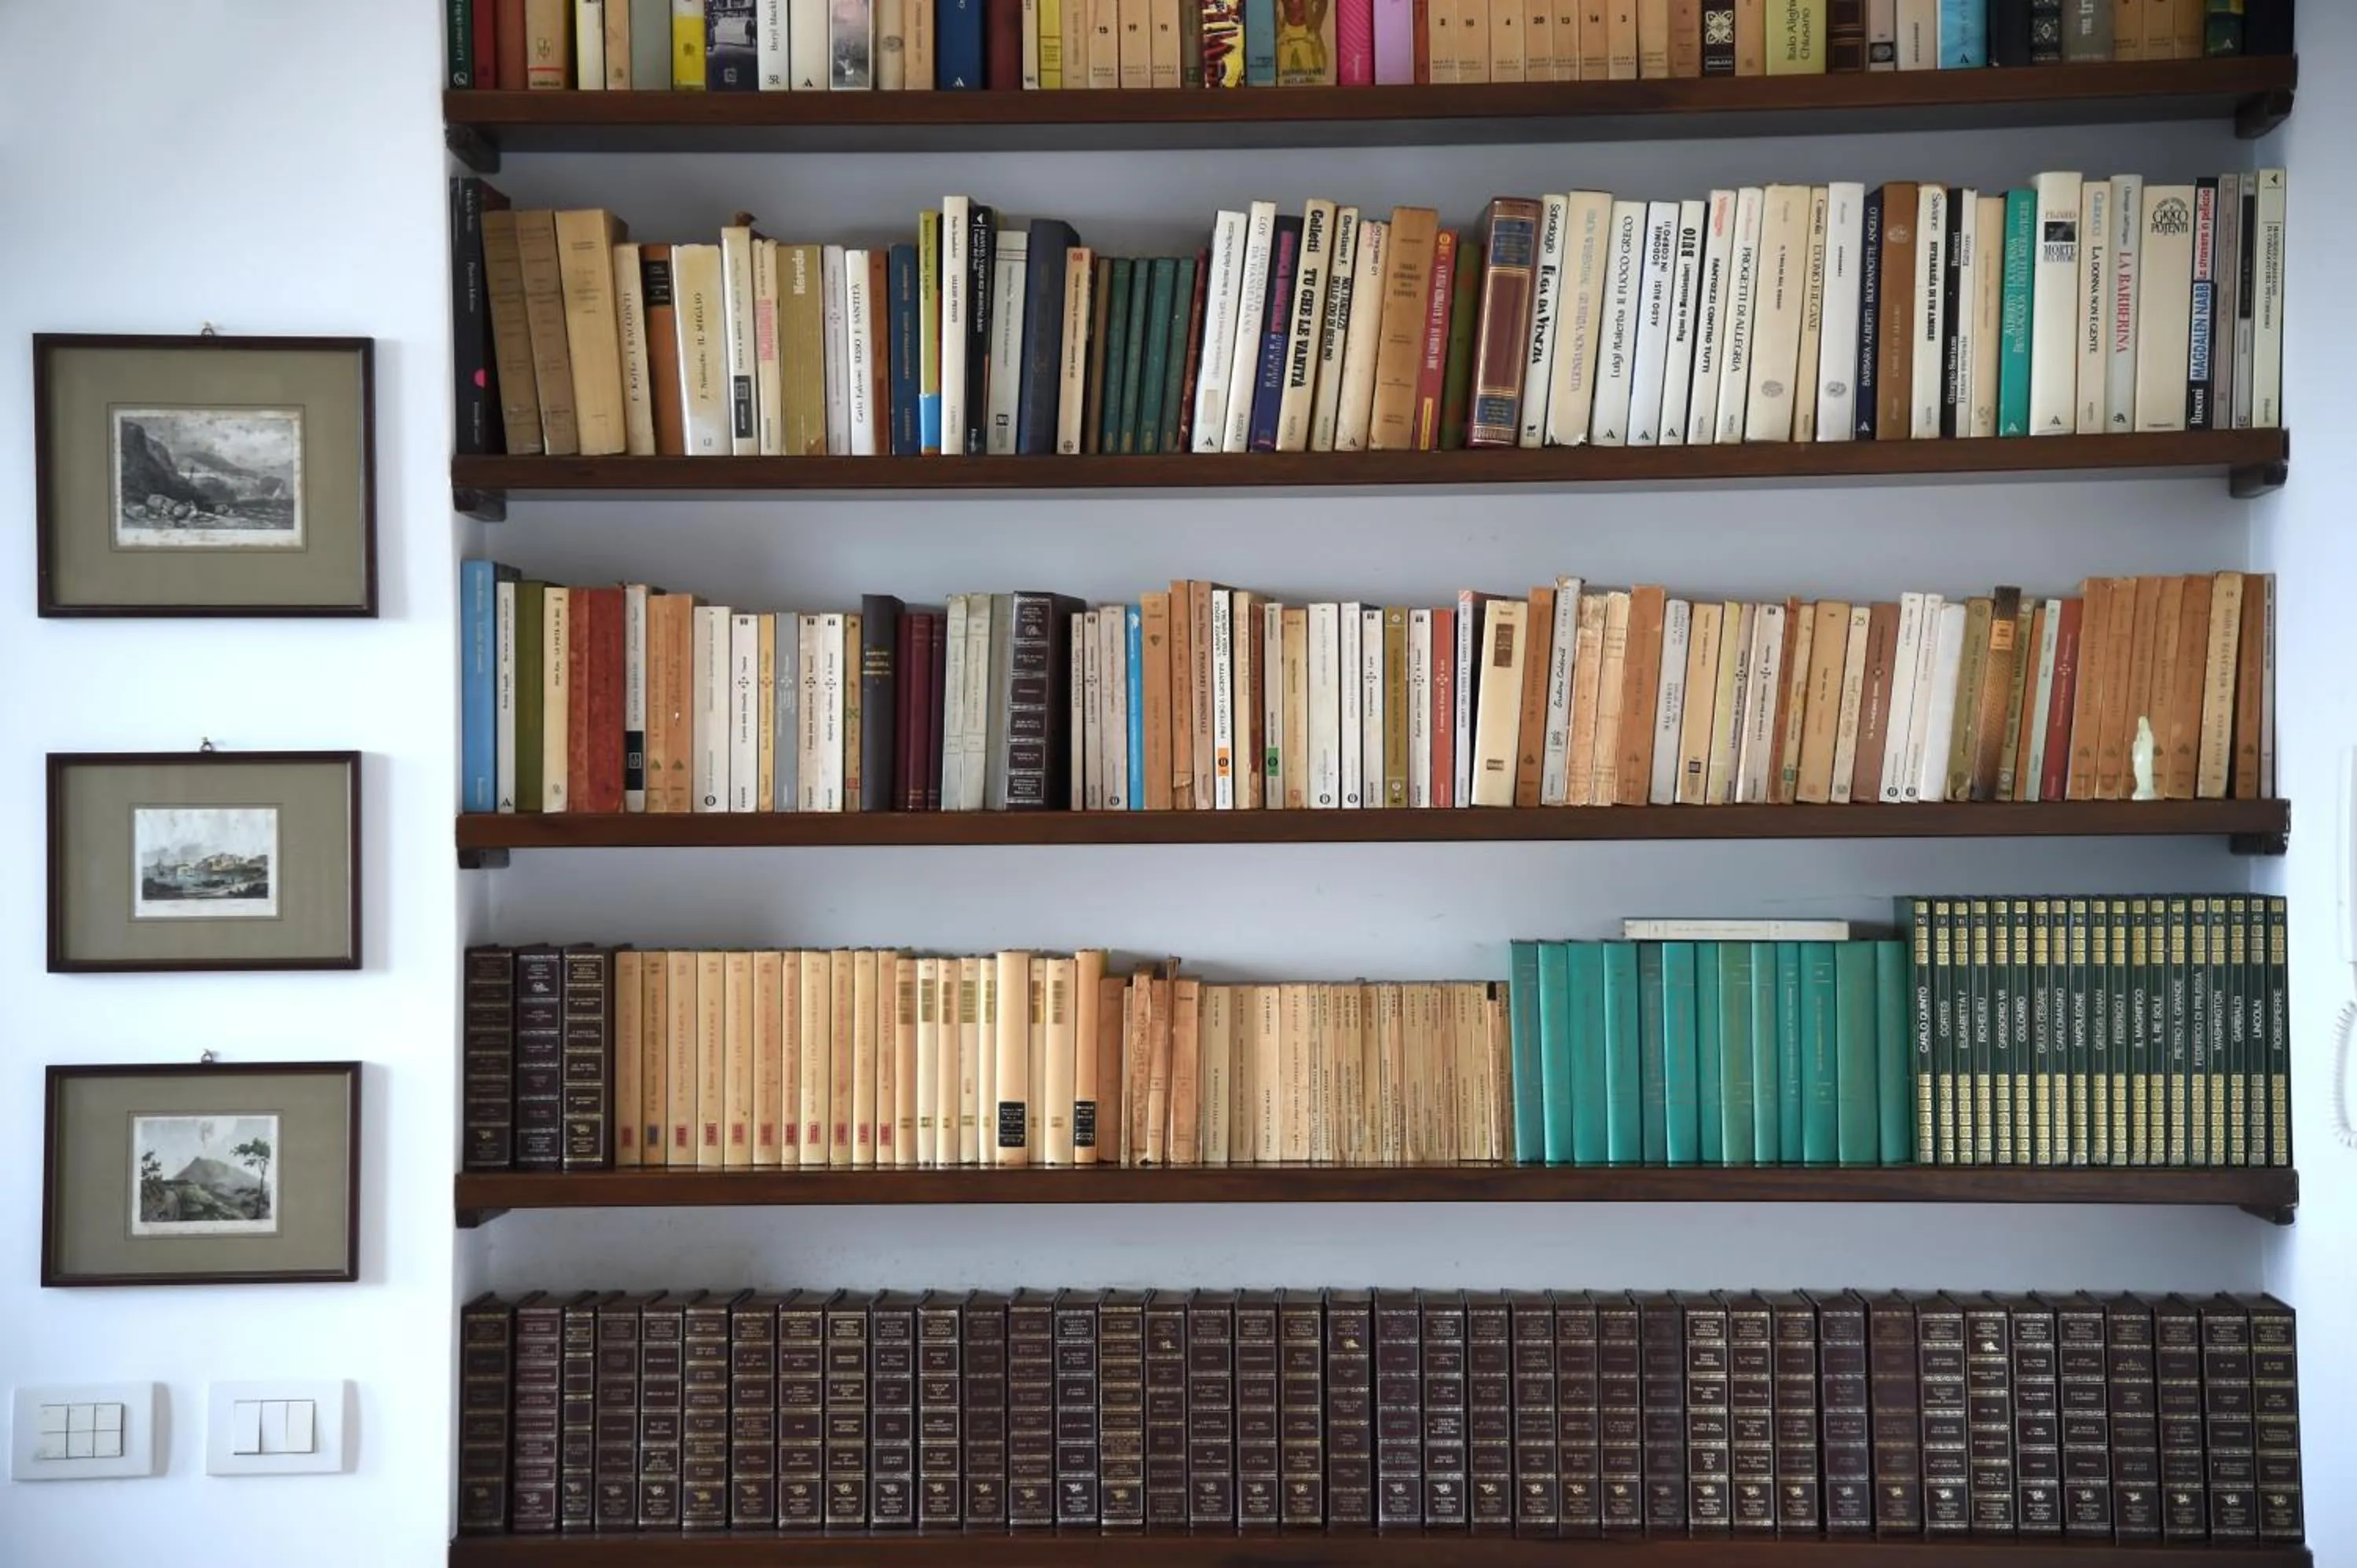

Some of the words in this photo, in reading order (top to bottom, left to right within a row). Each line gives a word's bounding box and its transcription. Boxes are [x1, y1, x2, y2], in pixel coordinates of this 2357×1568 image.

[769, 29, 780, 51] Beryl
[1787, 36, 1798, 61] Italo
[1800, 7, 1811, 60] Chiusano
[1814, 199, 1825, 235] Cassola
[1930, 192, 1942, 230] Saviane
[2200, 189, 2212, 221] pelliccia
[1258, 217, 1267, 236] LOY
[1340, 214, 1352, 259] Christiane
[1544, 203, 1560, 255] Salvalaggio
[1621, 215, 1633, 254] GRECO
[1681, 227, 1696, 258] BUIO
[1867, 207, 1878, 243] ANGELO
[2018, 200, 2029, 257] MERAVIGLIE
[2200, 222, 2209, 230] in
[1651, 225, 1662, 266] SODOMIE
[1661, 229, 1670, 260] CORPO
[2119, 252, 2132, 269] LA
[2198, 231, 2209, 268] straniera
[792, 249, 805, 295] Neruda
[1255, 246, 1268, 311] CIOCCOLATA
[1304, 268, 1318, 286] TU
[1618, 255, 1630, 295] FUOCO
[1660, 262, 1668, 273] IN
[1709, 258, 1720, 304] FANTOZZI
[1737, 247, 1753, 302] PROGETTI
[1811, 244, 1822, 283] L'UOMO
[2017, 258, 2027, 288] DELLE
[2091, 262, 2101, 295] DONNA
[1329, 275, 1341, 299] DELLO
[1652, 280, 1662, 300] BUSI
[1810, 291, 1819, 302] IL
[1928, 288, 1937, 299] DI
[2007, 275, 2017, 288] LA
[694, 292, 704, 332] MEGLIO
[851, 284, 861, 324] SANTITÀ
[1299, 289, 1314, 317] CHE
[1327, 301, 1338, 317] ZOO
[1338, 295, 1351, 330] RAGAZZI
[1537, 299, 1548, 315] DA
[1651, 302, 1659, 327] ALDO
[1736, 304, 1747, 317] DI
[1808, 302, 1819, 332] CANE
[1927, 299, 1937, 310] UN
[2005, 294, 2015, 336] ALBERTO
[2090, 296, 2099, 315] NON
[2116, 273, 2132, 353] BARBERINA
[2194, 285, 2209, 315] NABB
[624, 292, 635, 346] RACCONTI
[1297, 319, 1311, 337] LE
[1325, 318, 1336, 328] DI
[1613, 310, 1625, 351] Malerba
[1705, 306, 1716, 344] CONTRO
[1864, 309, 1874, 344] ALBERTI
[1927, 311, 1936, 342] AMORE
[2014, 294, 2026, 353] BEVILACQUA
[854, 339, 863, 365] SESSO
[1323, 328, 1335, 361] BERLINO
[1532, 316, 1550, 365] VENEZIA
[1574, 335, 1585, 350] NON
[1731, 318, 1747, 372] ALLEGRIA
[2089, 323, 2099, 354] GENTE
[2192, 318, 2208, 378] MAGDALEN
[1291, 339, 1310, 388] VANITÀ
[1571, 350, 1585, 393] VENDETTA
[1611, 353, 1623, 378] Luigi
[1702, 346, 1712, 374] TUTTI
[1862, 346, 1871, 387] BARBARA
[1948, 371, 1958, 404] Giorgio
[2191, 389, 2204, 424] Rusconi
[1918, 986, 1928, 1020] QUINTO
[2036, 987, 2046, 1023] CESARE
[2172, 978, 2183, 1017] GRANDE
[2194, 972, 2204, 1010] PRUSSIA
[1958, 997, 1968, 1049] ELISABETTA
[1977, 997, 1987, 1042] RICHELIEU
[1997, 1002, 2007, 1049] GREGORIO
[2016, 996, 2026, 1042] COLOMBO
[2055, 987, 2066, 1051] CARLOMAGNO
[2074, 993, 2084, 1047] NAPOLEONE
[2114, 1001, 2124, 1045] FEDERICO
[2134, 988, 2145, 1039] MAGNIFICO
[2153, 1021, 2163, 1034] RE
[2194, 1011, 2204, 1021] DI
[2213, 990, 2223, 1051] WASHINGTON
[2232, 995, 2243, 1042] GARIBALDI
[2252, 1000, 2263, 1039] LINCOLN
[2273, 987, 2283, 1050] ROBESPIERRE
[1919, 1023, 1929, 1053] CARLO
[2036, 1024, 2047, 1053] GIULIO
[2095, 1017, 2105, 1051] GENGIS
[2134, 1039, 2144, 1048] IL
[2173, 1027, 2183, 1061] PIETRO
[2194, 1023, 2205, 1067] FEDERICO
